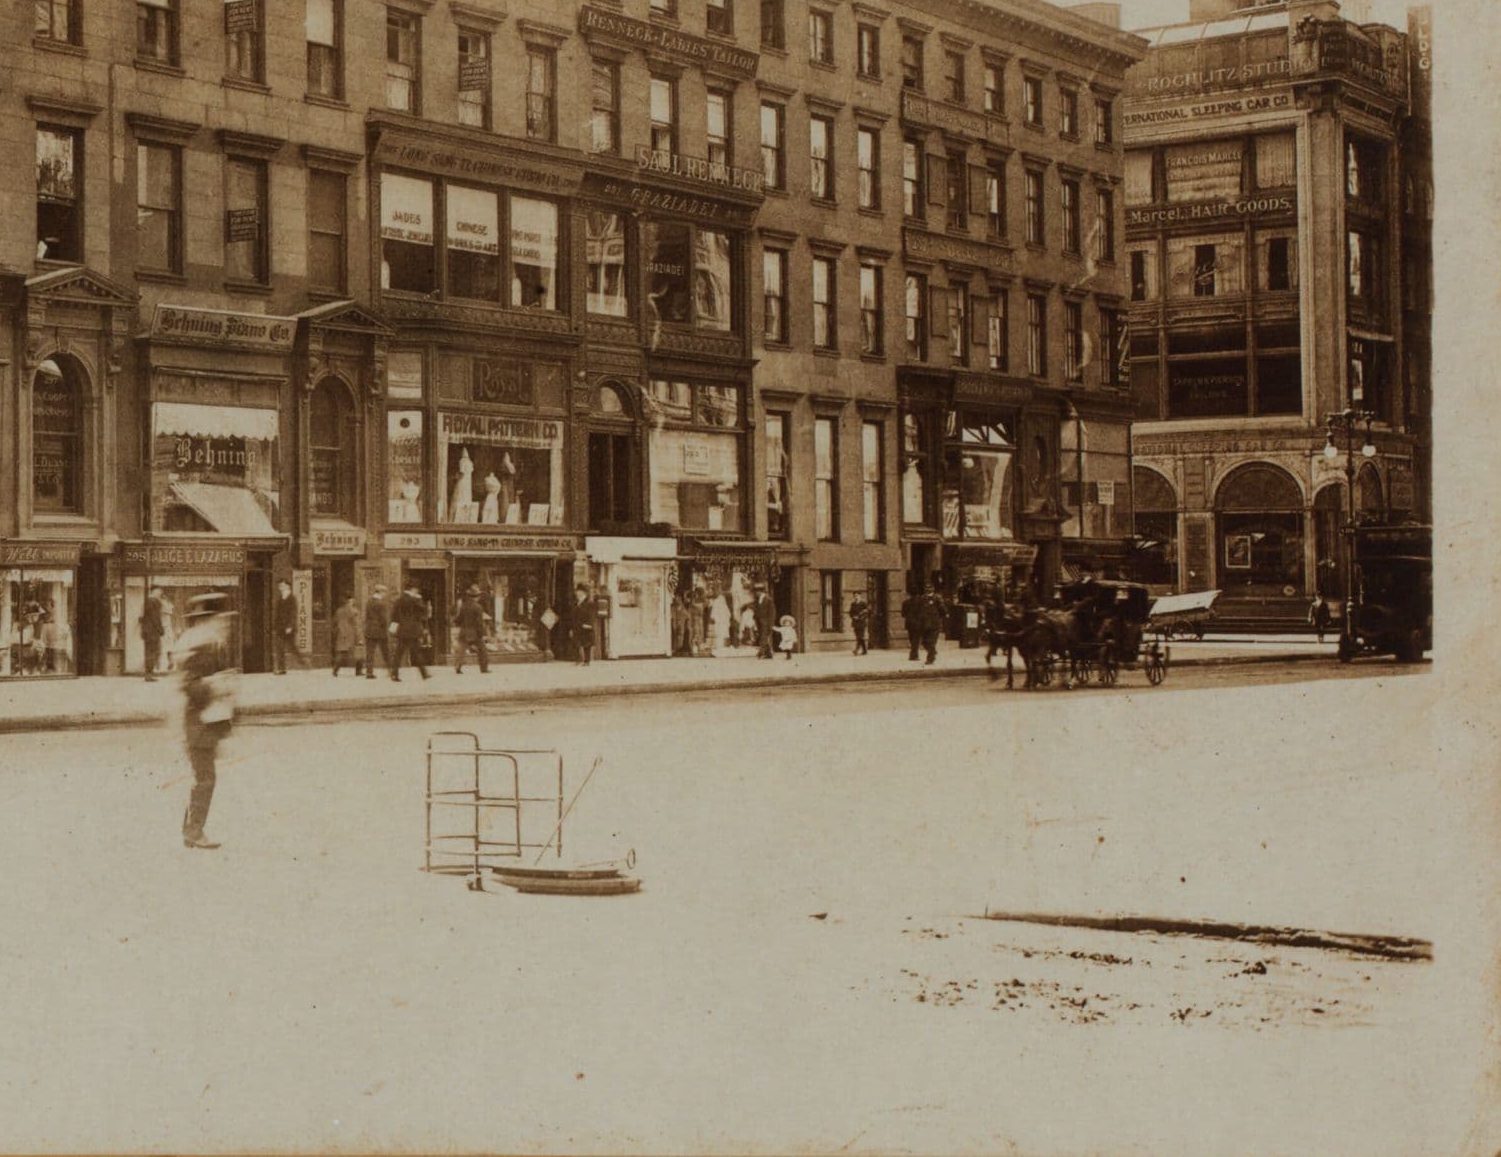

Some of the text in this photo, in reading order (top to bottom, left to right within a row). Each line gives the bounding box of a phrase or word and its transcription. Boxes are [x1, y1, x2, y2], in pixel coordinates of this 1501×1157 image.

[1190, 101, 1244, 123] SLEEPING
[1245, 97, 1271, 113] CAR
[1273, 94, 1289, 108] CO
[636, 148, 684, 176] SAUL
[1191, 203, 1231, 219] HAIR
[442, 414, 485, 435] ROYAL
